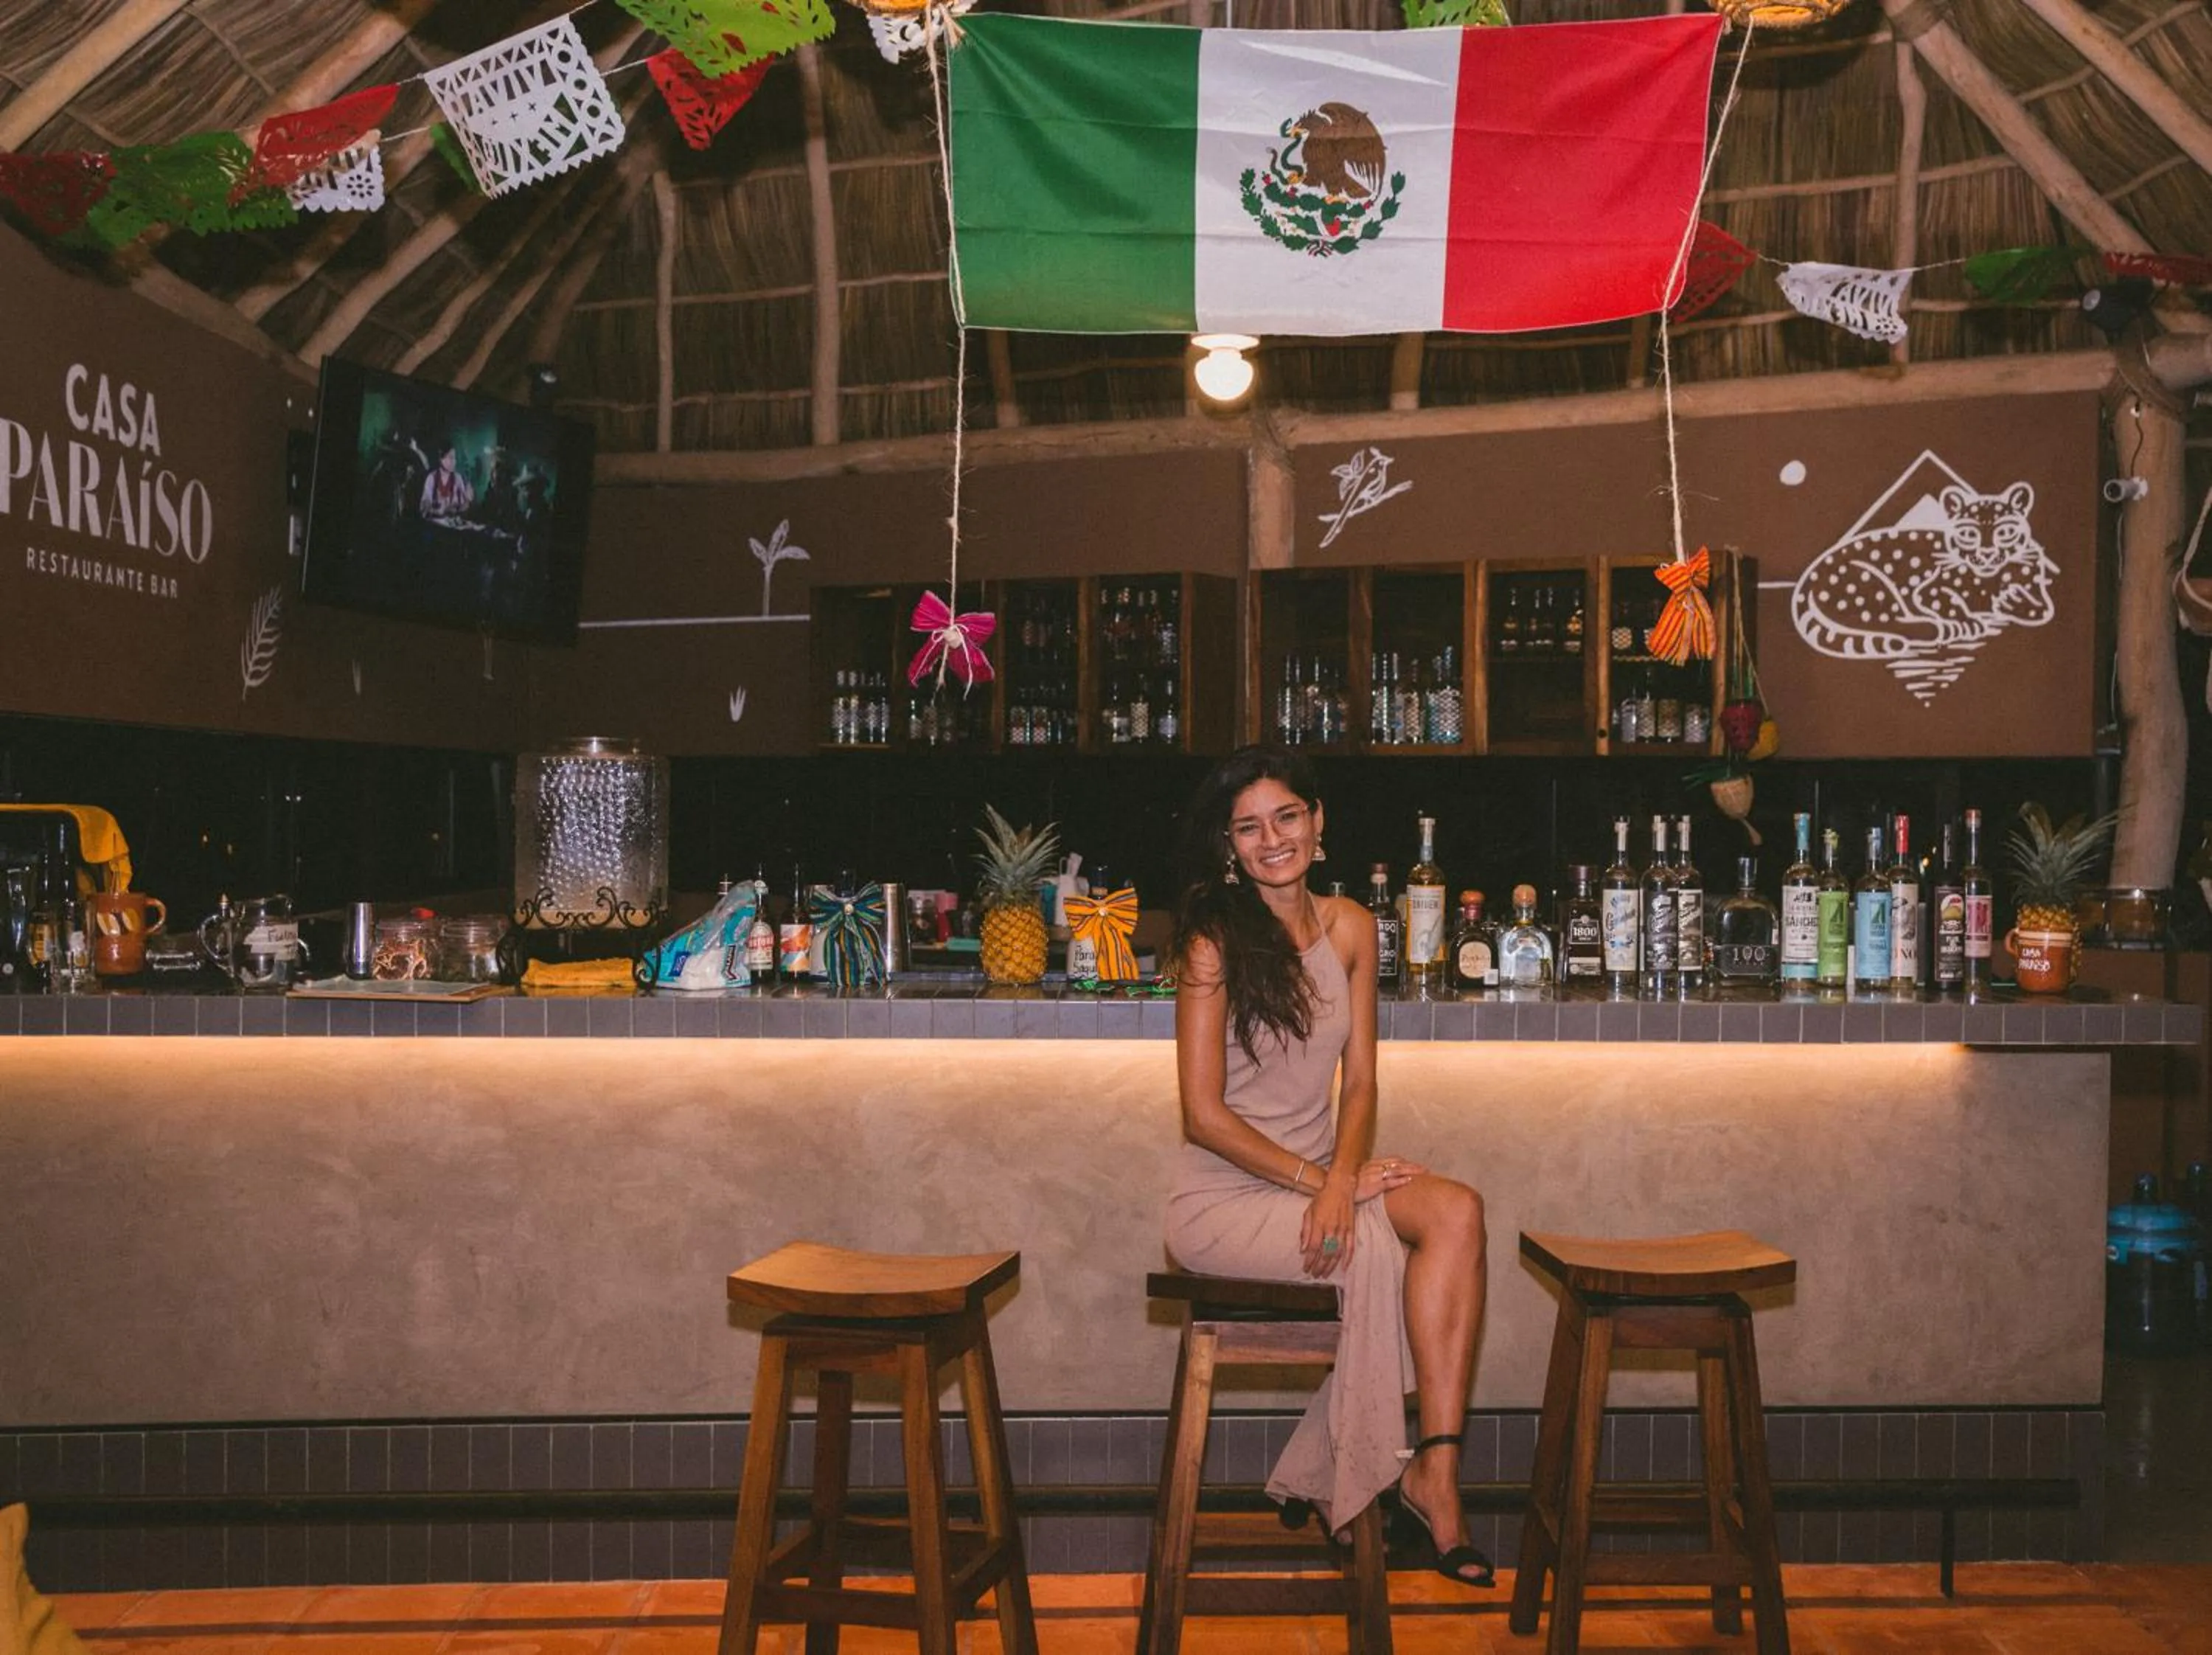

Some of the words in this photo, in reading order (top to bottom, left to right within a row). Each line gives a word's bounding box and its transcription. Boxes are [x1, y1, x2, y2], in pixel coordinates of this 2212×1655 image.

[65, 363, 161, 457] CASA
[0, 416, 212, 565] PARAÍSO
[27, 547, 145, 592] RESTAURANTE
[150, 573, 178, 599] BAR
[1573, 926, 1597, 937] 1800
[1733, 946, 1766, 962] 100
